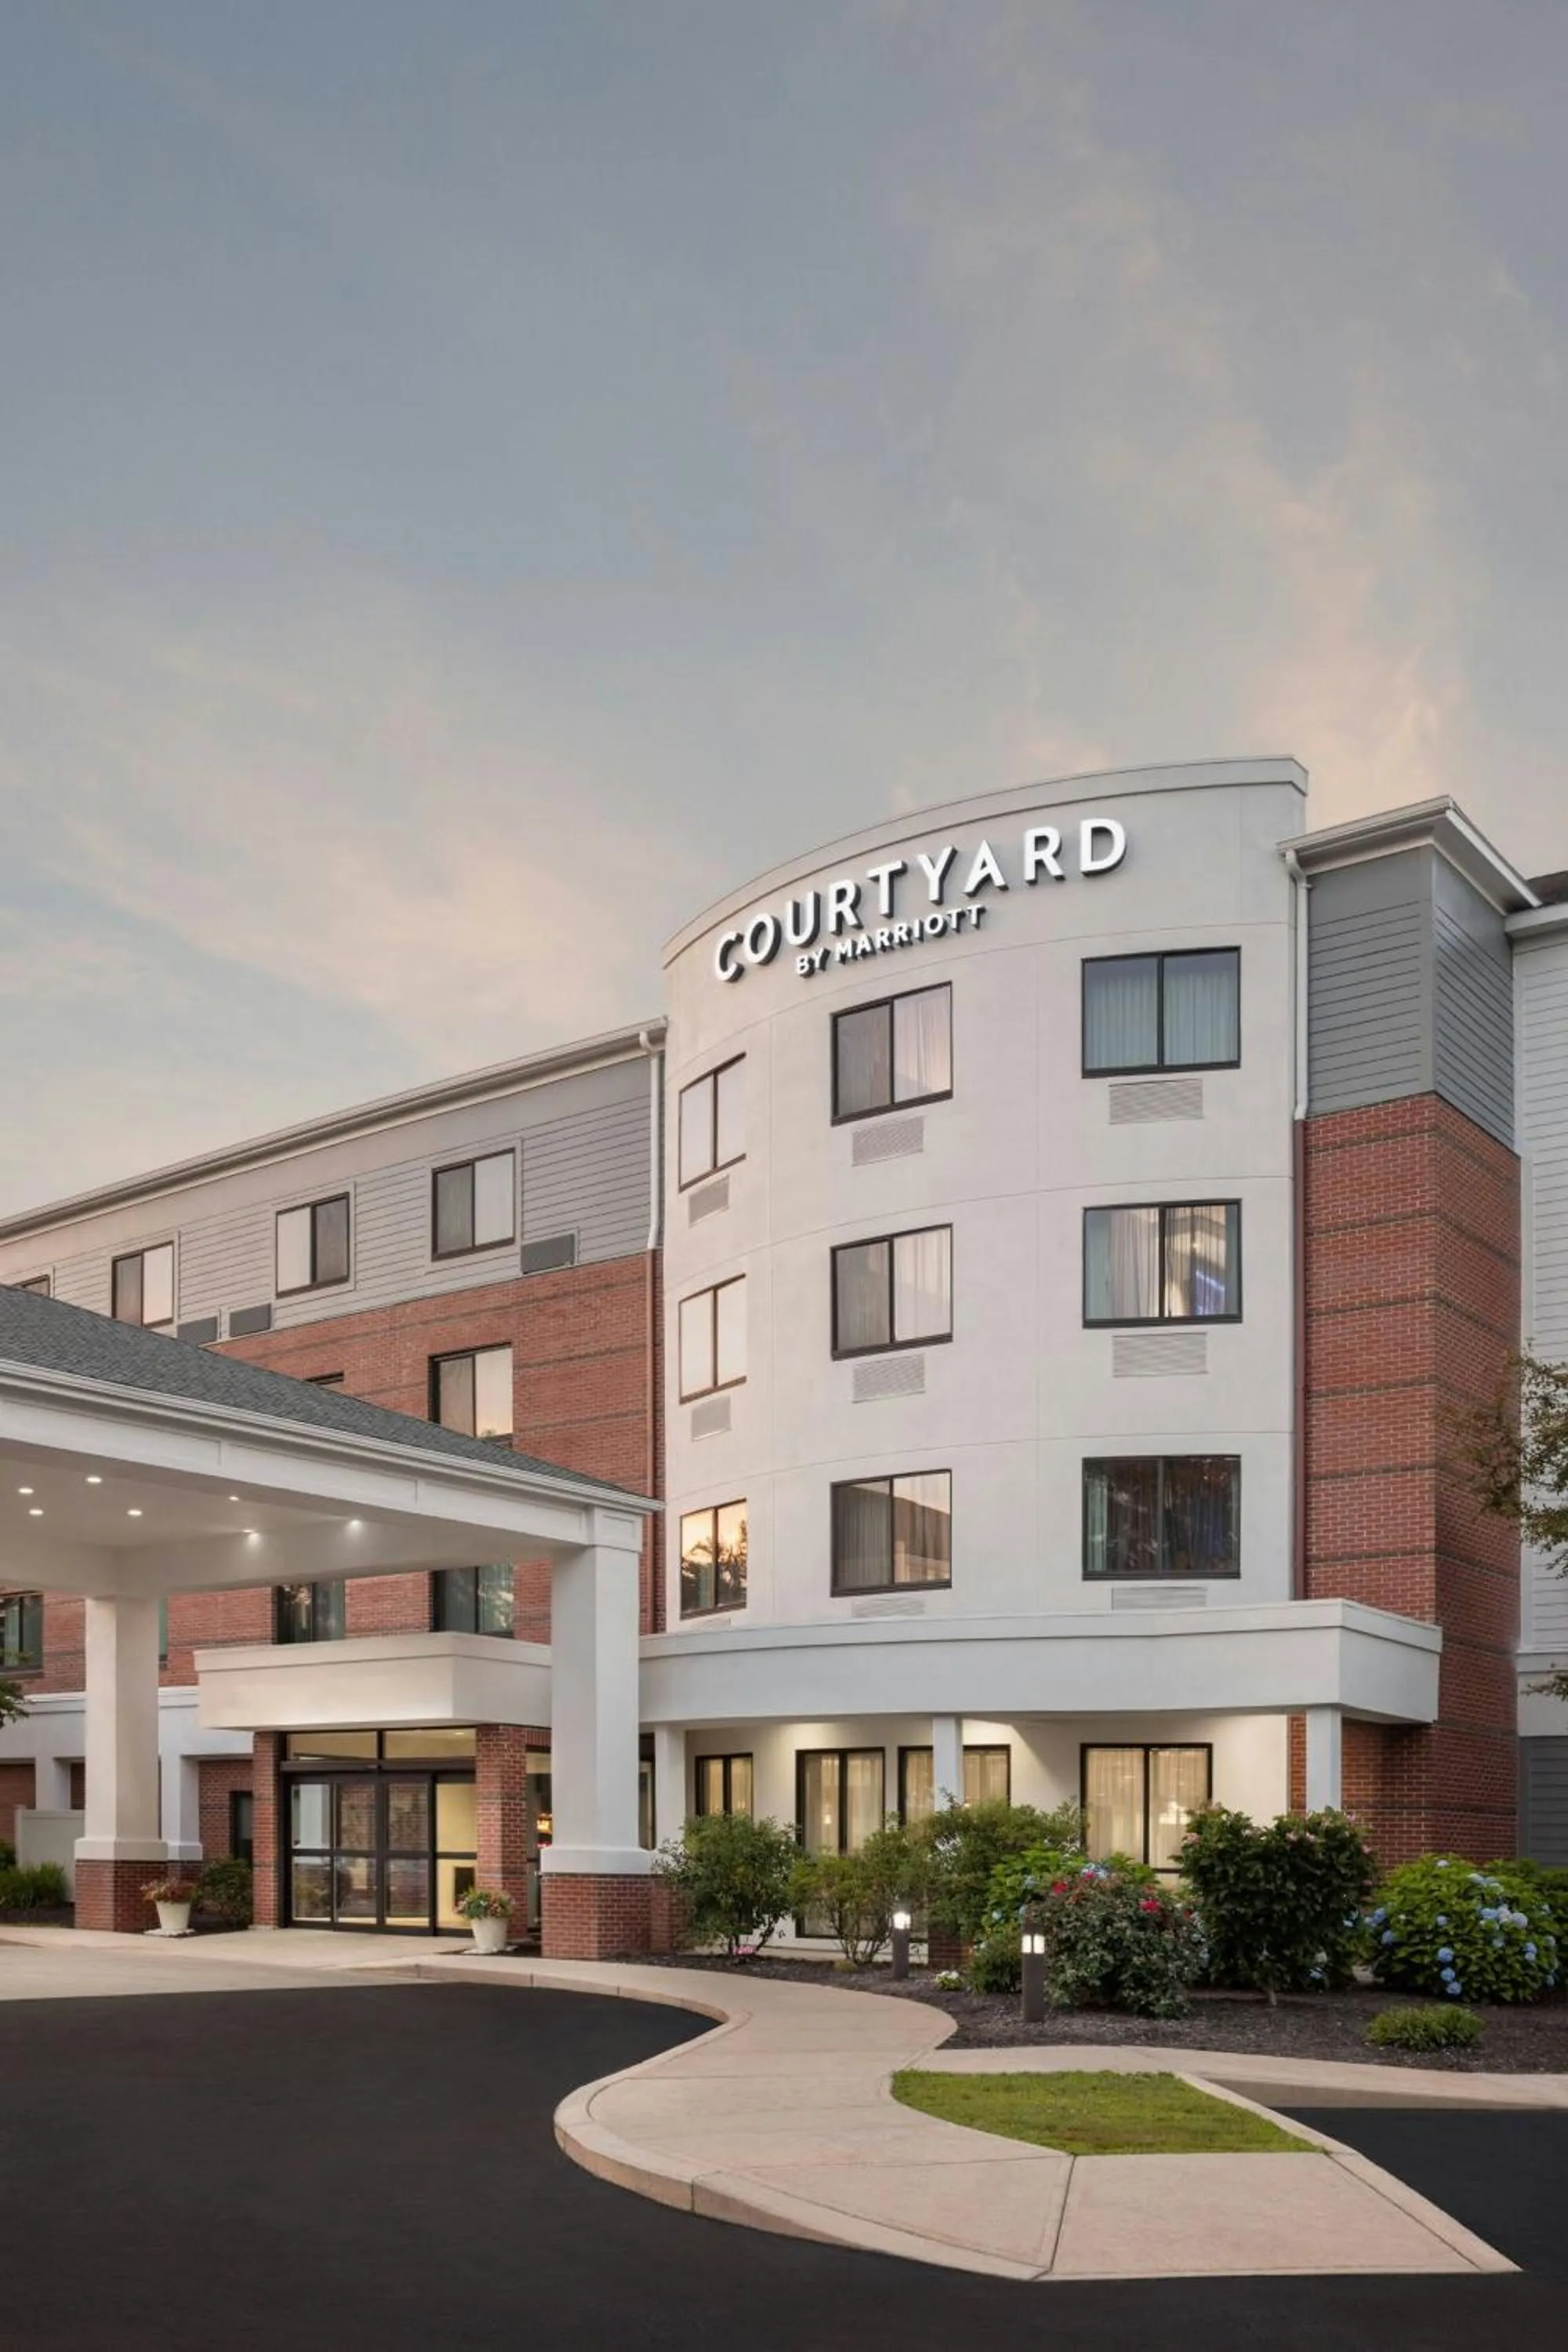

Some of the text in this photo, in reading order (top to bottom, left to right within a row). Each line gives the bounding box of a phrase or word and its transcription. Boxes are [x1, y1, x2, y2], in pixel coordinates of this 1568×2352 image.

[714, 818, 1127, 982] COURTYARD
[795, 905, 985, 978] BY MARRIOTT
